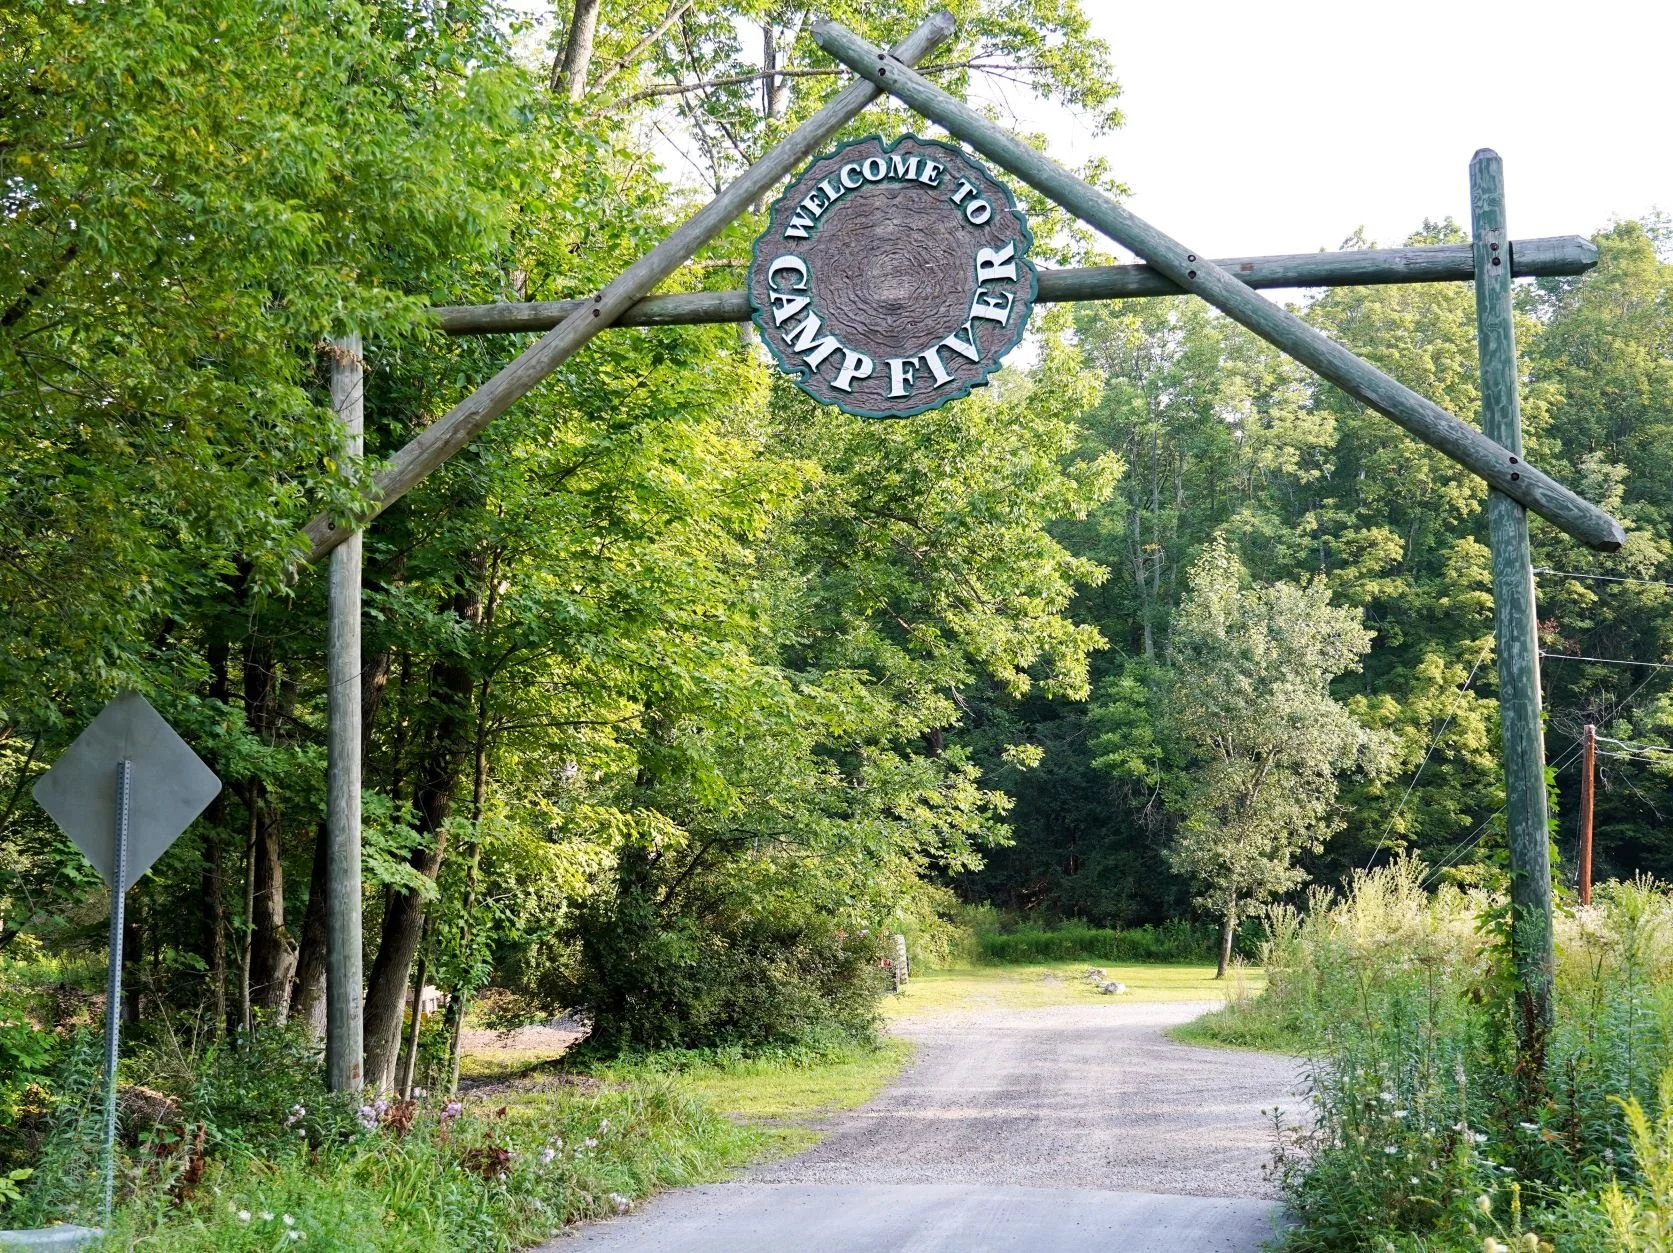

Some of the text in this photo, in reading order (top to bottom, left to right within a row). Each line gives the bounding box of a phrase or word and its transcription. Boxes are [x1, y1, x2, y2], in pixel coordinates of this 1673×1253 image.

[784, 154, 992, 240] WELCOME TO
[768, 239, 1017, 399] CAMP FIVER
